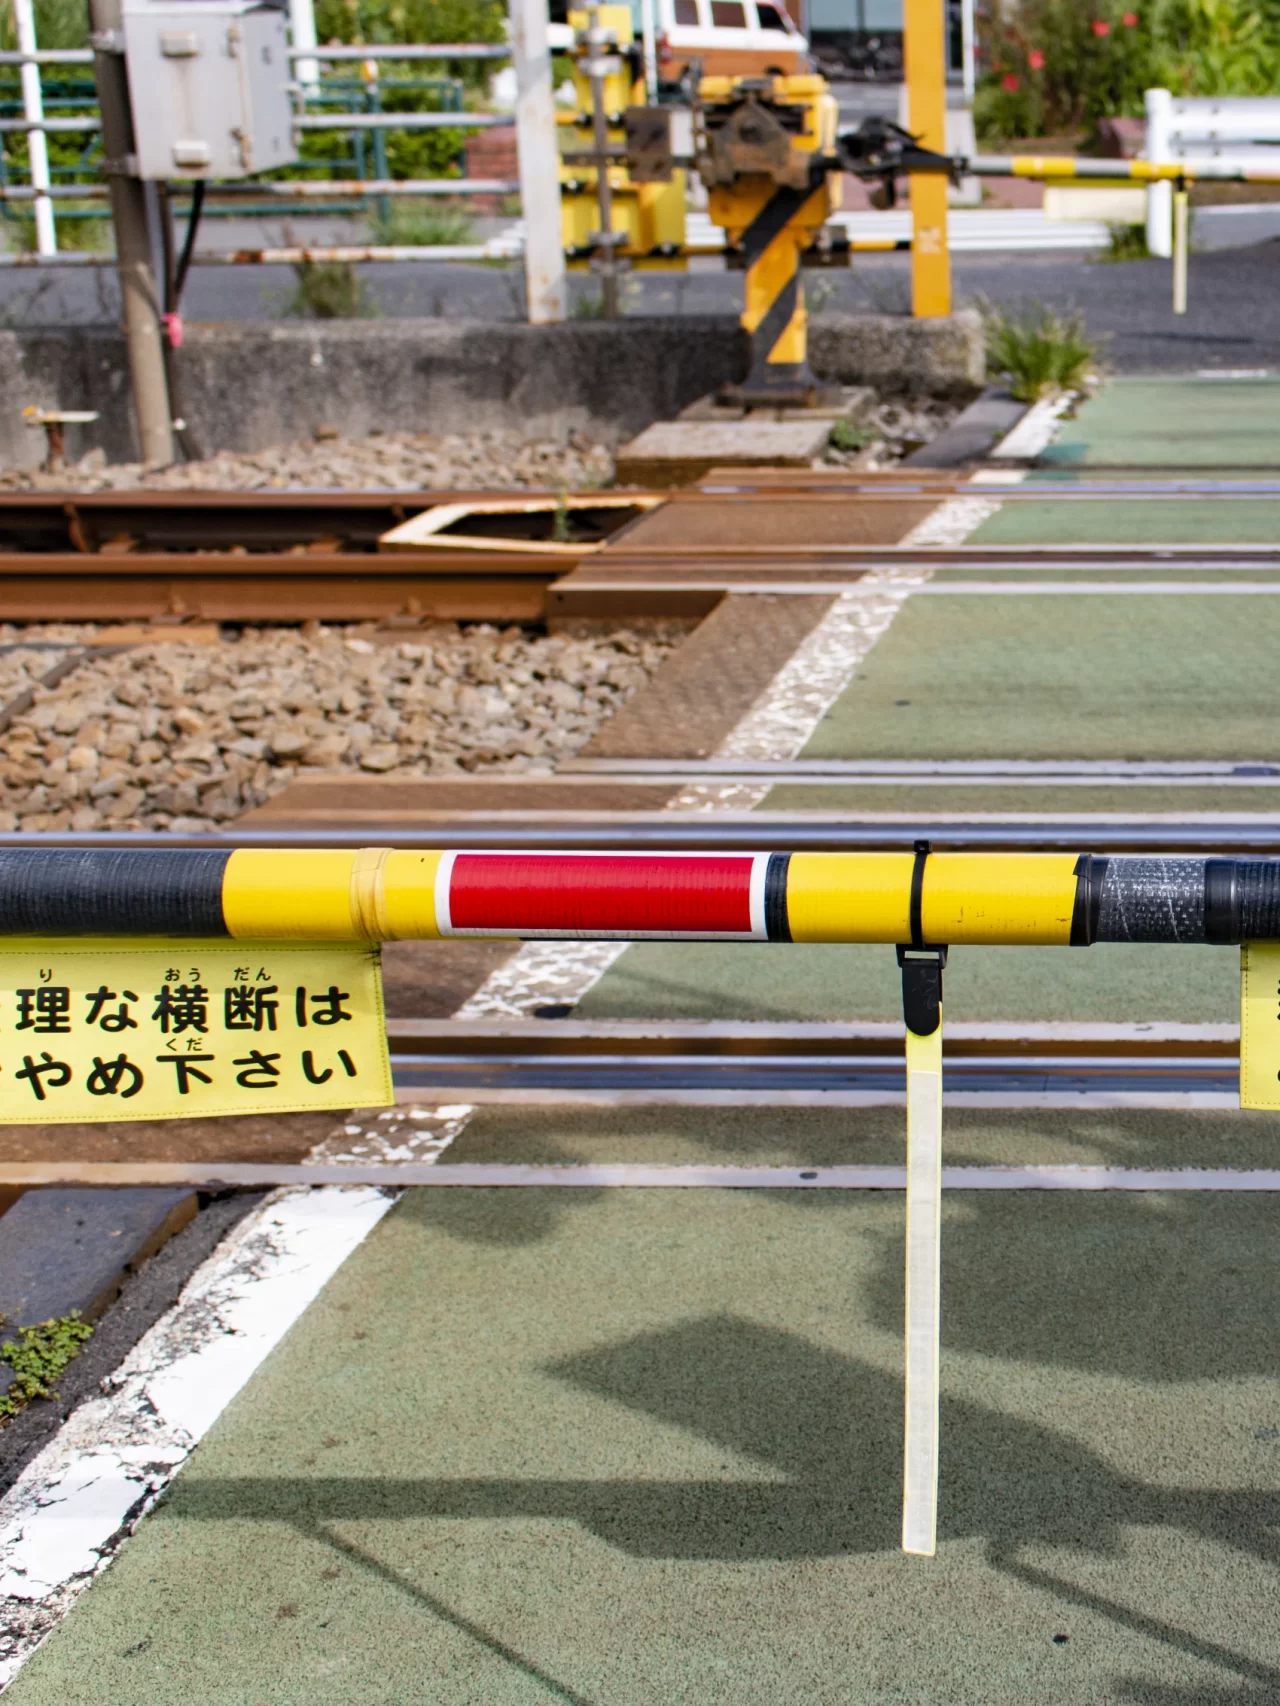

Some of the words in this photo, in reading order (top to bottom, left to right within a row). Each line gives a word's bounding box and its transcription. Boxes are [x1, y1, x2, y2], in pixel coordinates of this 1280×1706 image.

[39, 968, 52, 983] り
[165, 967, 201, 982] おう
[233, 967, 272, 982] だん
[0, 985, 353, 1034] 理な横断は
[165, 1038, 203, 1051] くだ
[0, 1049, 357, 1101] やめ下さい
